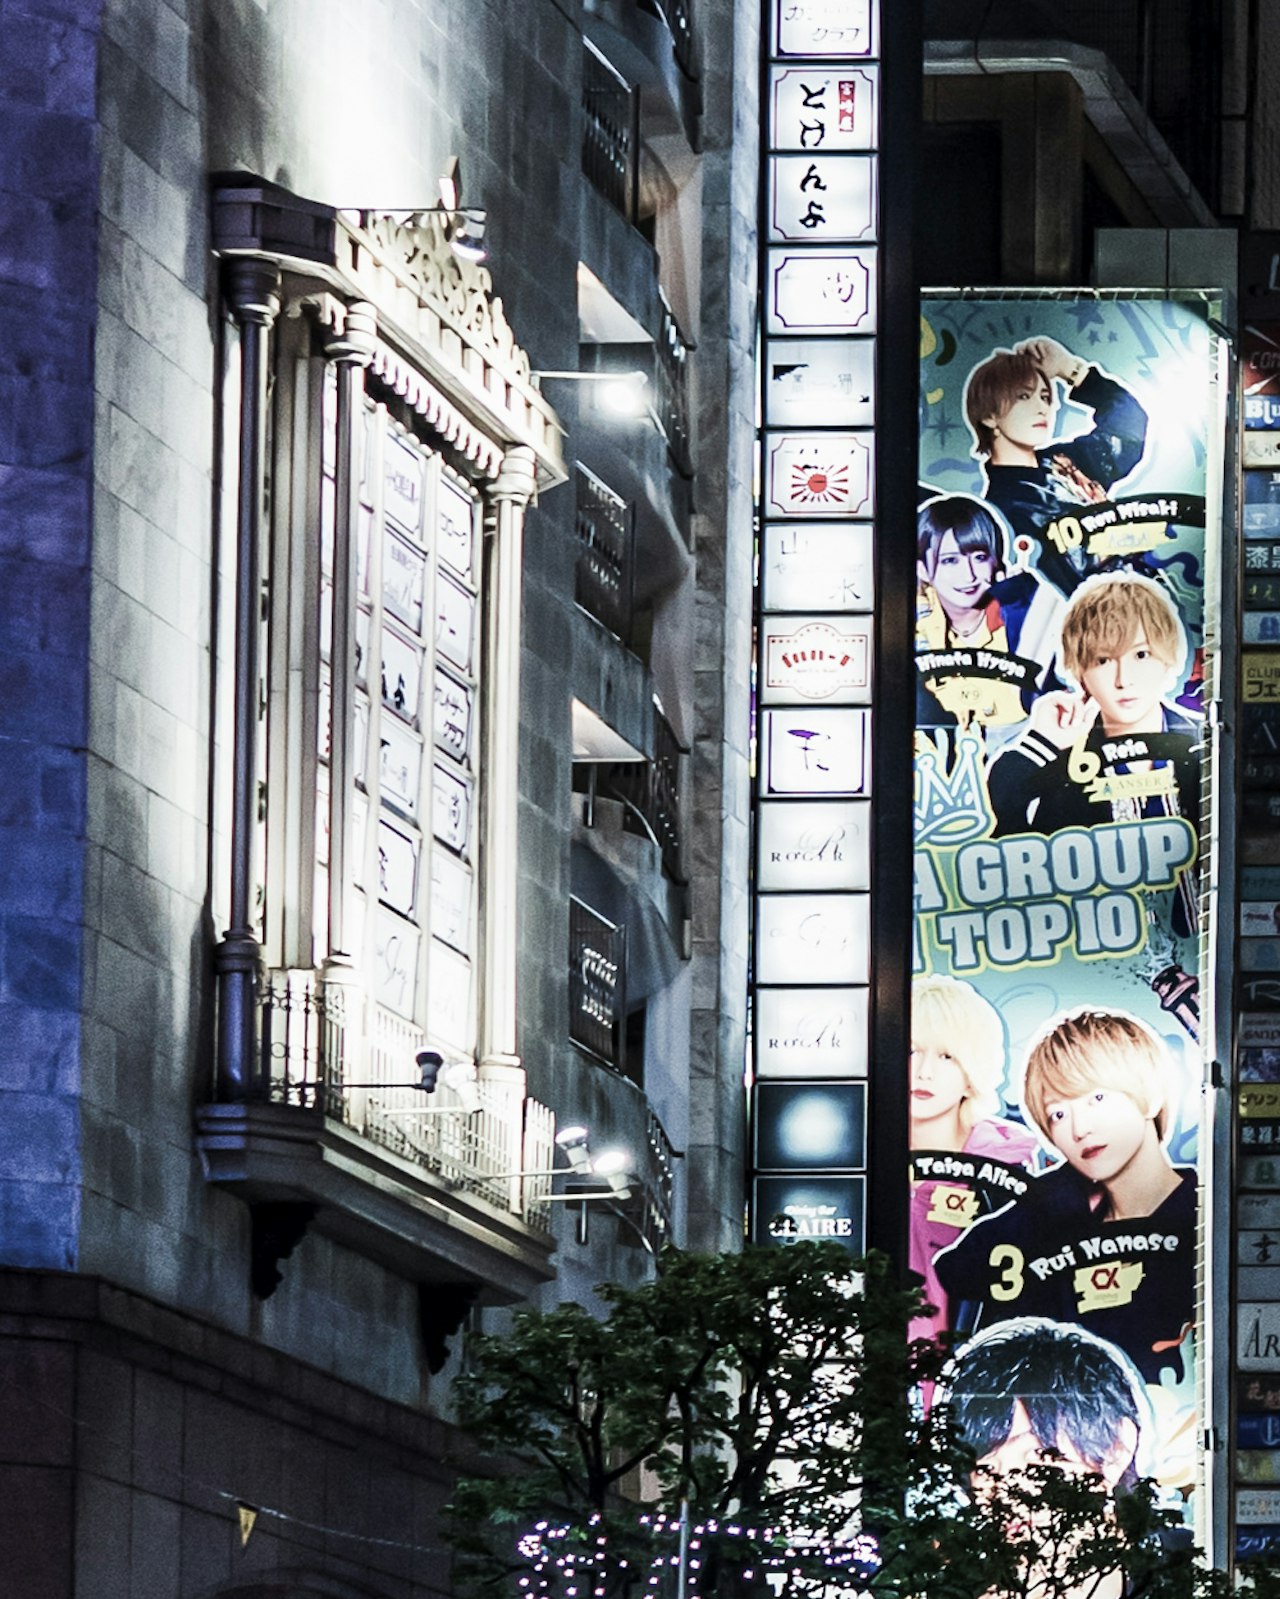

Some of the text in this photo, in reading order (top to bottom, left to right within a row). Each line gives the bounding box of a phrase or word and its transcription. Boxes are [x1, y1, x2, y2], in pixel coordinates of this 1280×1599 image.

[1047, 516, 1083, 554] 10
[1068, 739, 1101, 784] 6
[957, 822, 1192, 907] GROUP
[915, 1156, 1028, 1195] Taiga Alice
[989, 1233, 1180, 1302] 3 Rui Nanase
